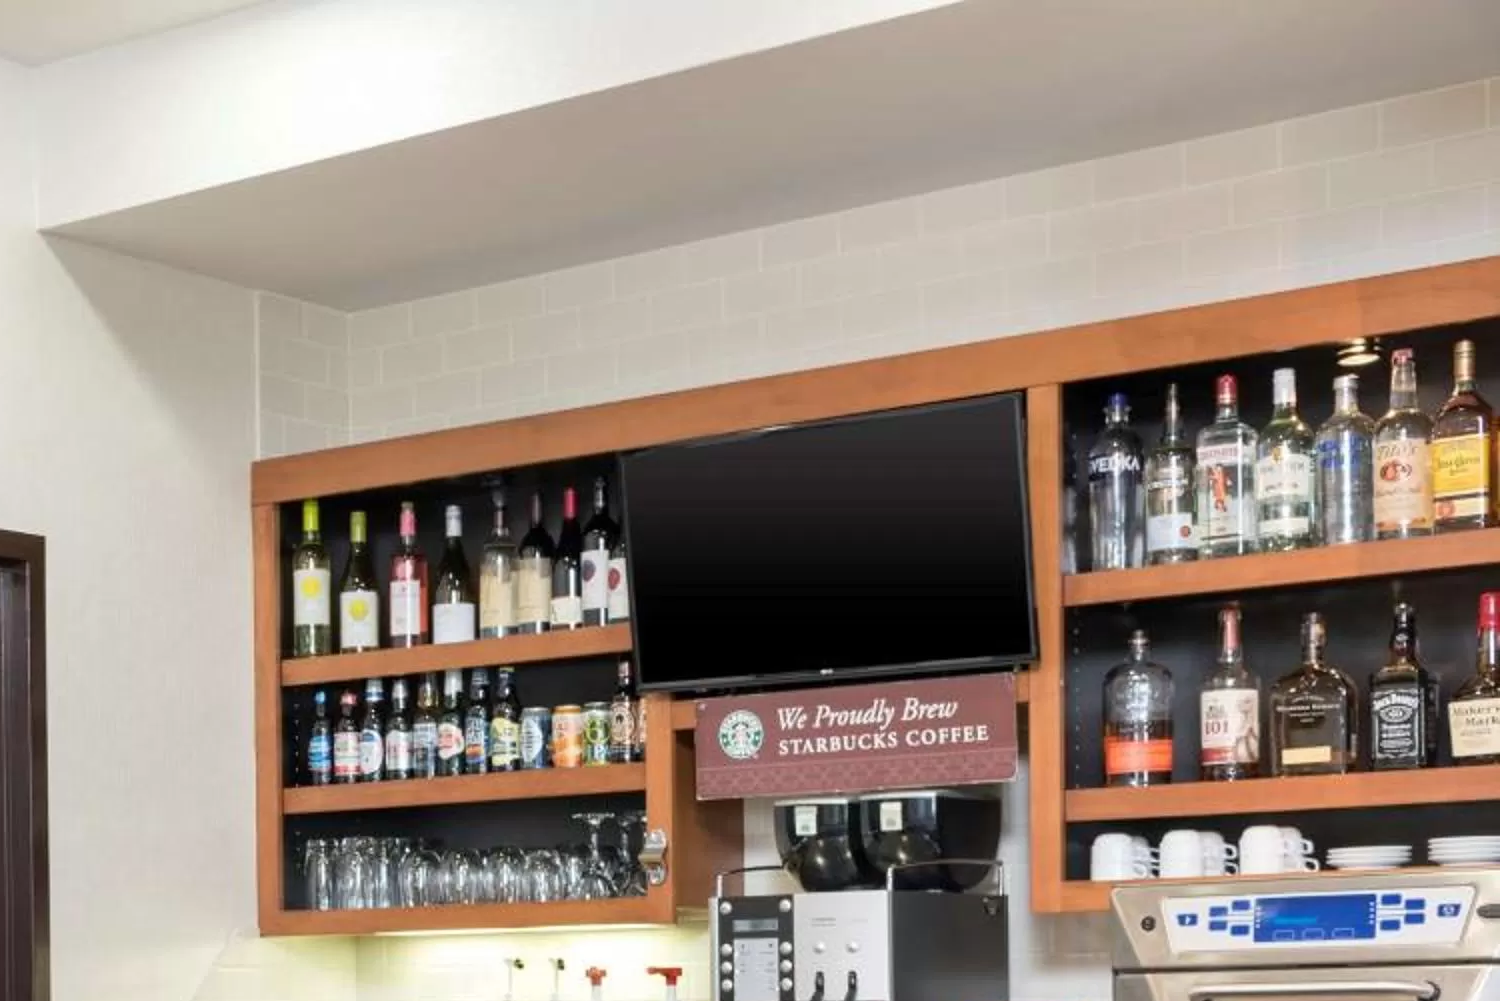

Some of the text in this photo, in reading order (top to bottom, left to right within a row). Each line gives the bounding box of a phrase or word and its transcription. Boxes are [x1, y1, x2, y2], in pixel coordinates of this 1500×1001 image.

[777, 697, 959, 731] We Proudly Brew
[778, 731, 898, 756] STARBUCKS
[905, 725, 989, 747] COFFEE
